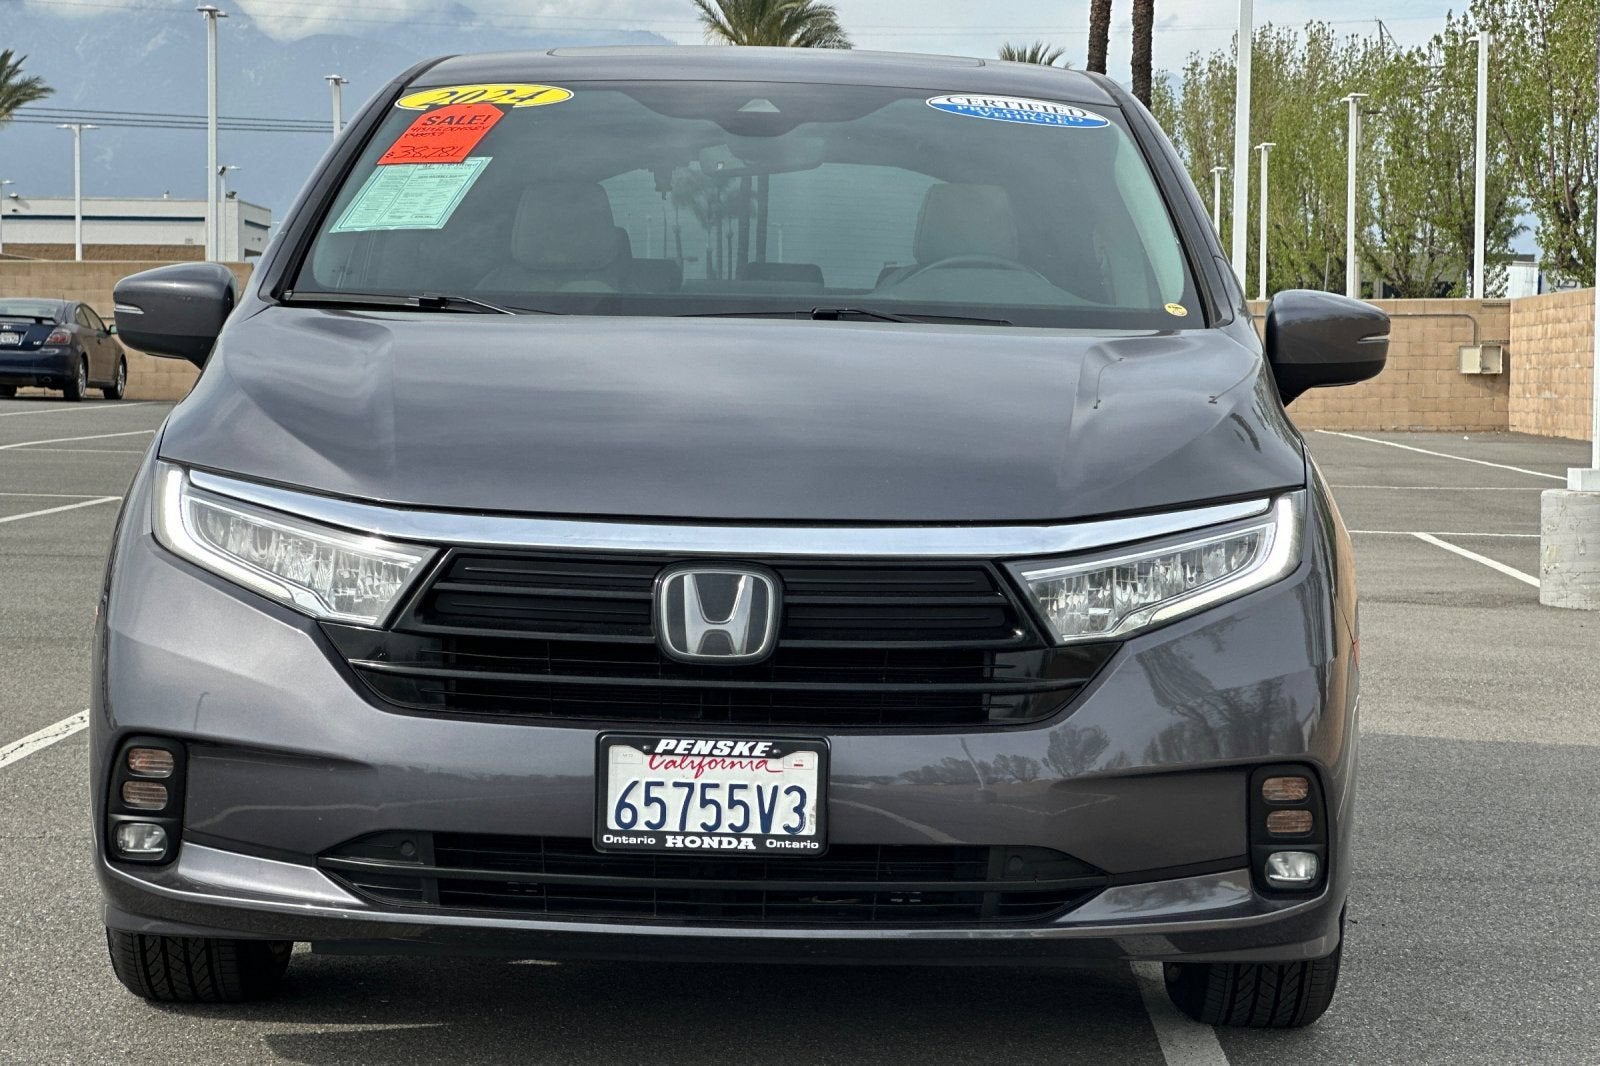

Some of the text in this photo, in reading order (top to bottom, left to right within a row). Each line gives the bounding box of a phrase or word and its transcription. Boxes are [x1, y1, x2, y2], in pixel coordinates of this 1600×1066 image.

[417, 89, 551, 106] 2024
[947, 97, 1087, 117] CERTIFIED
[956, 105, 1085, 122] PRE-OWNED
[422, 114, 492, 126] SALE!
[978, 109, 1069, 125] VEHICLE
[654, 739, 773, 757] PENSKE
[649, 754, 783, 779] California
[614, 780, 807, 834] 65755V3
[602, 834, 819, 850] Ontario HONDA Ontario
